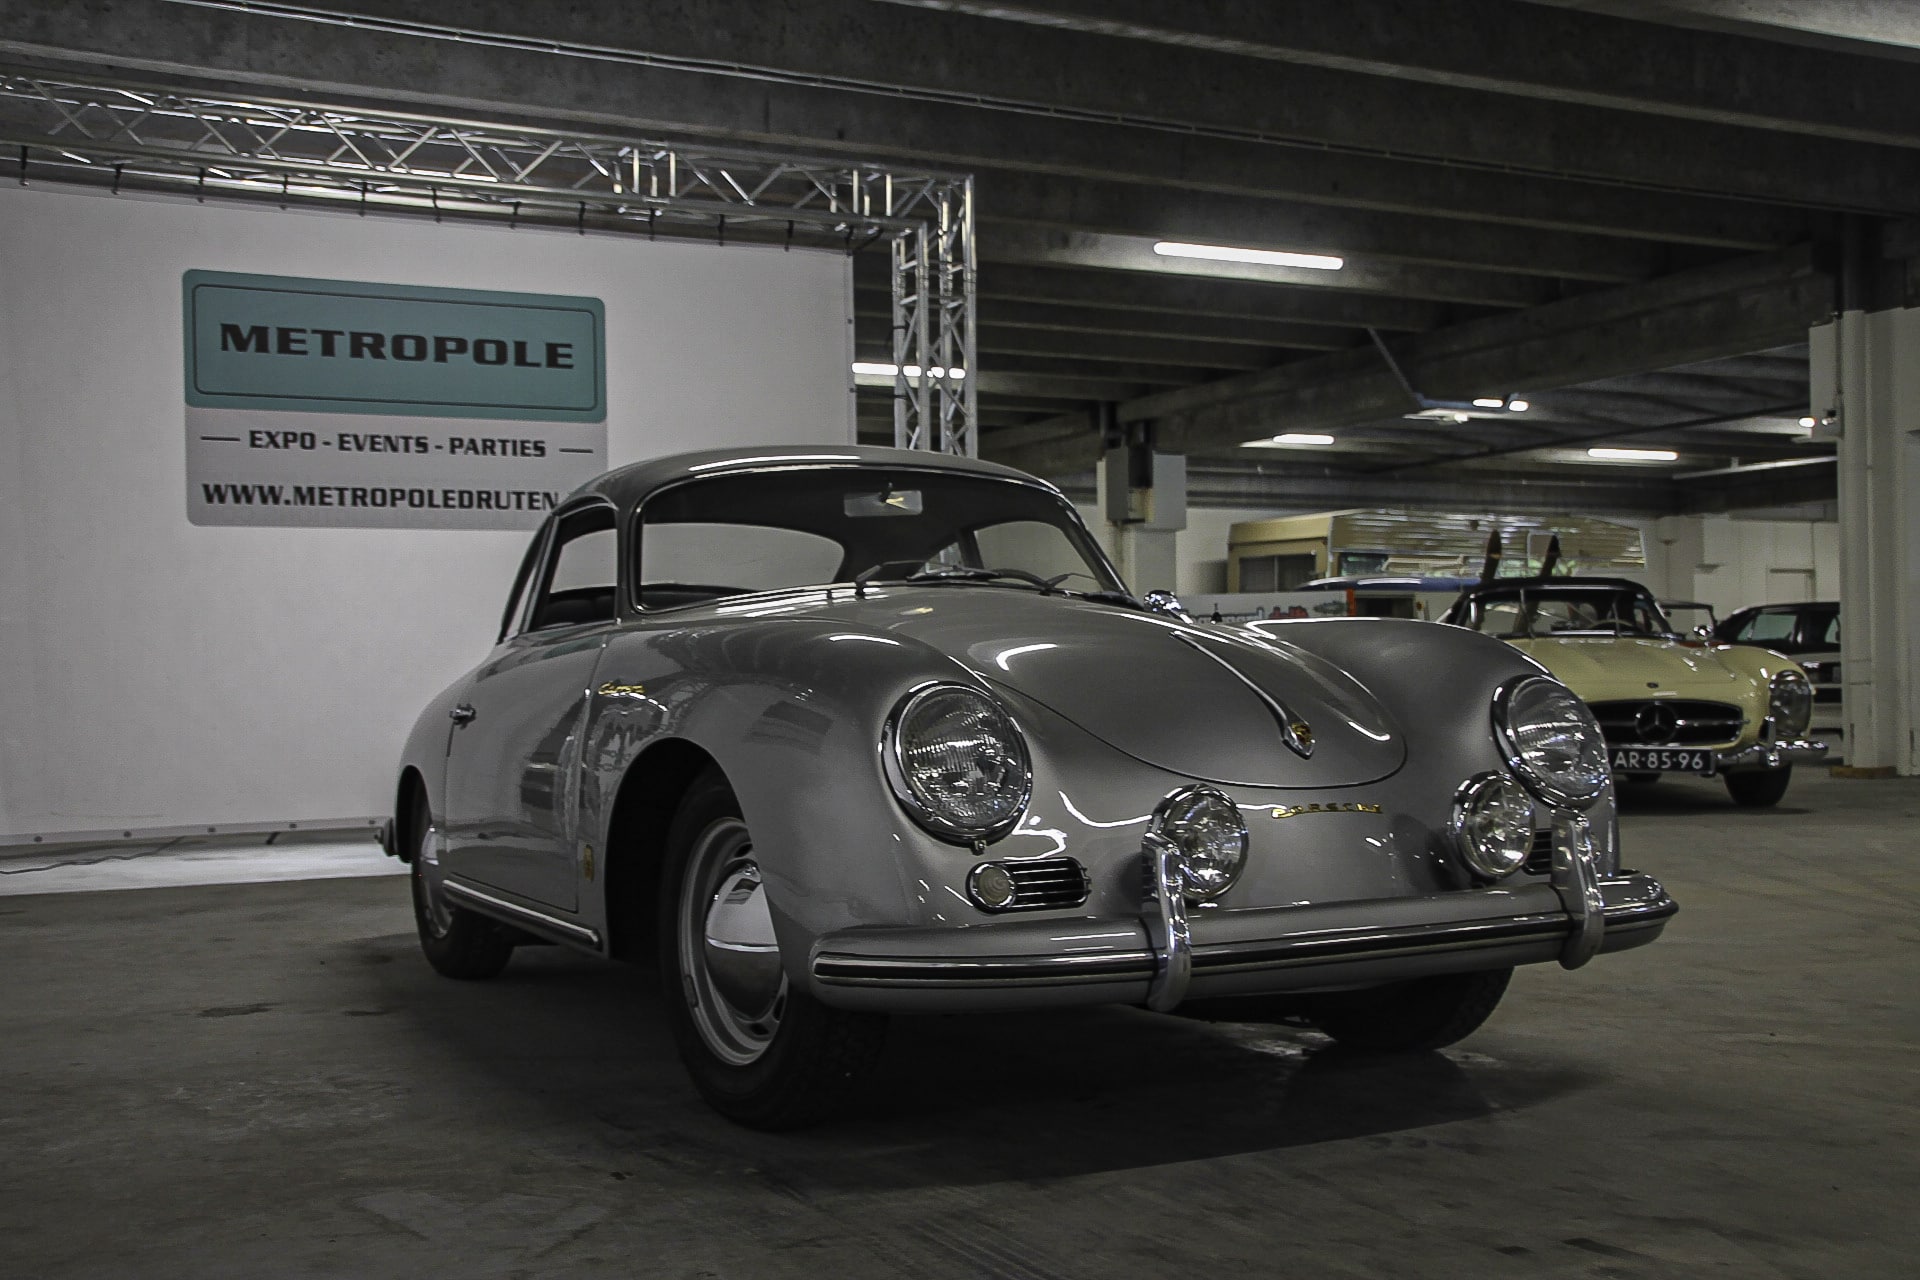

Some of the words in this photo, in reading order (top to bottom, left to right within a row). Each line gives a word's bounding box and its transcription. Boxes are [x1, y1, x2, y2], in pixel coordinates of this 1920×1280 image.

[220, 323, 575, 369] METROPOLE
[249, 430, 316, 451] EXPO
[338, 433, 429, 454] EVENTS
[449, 437, 546, 458] PARTIES
